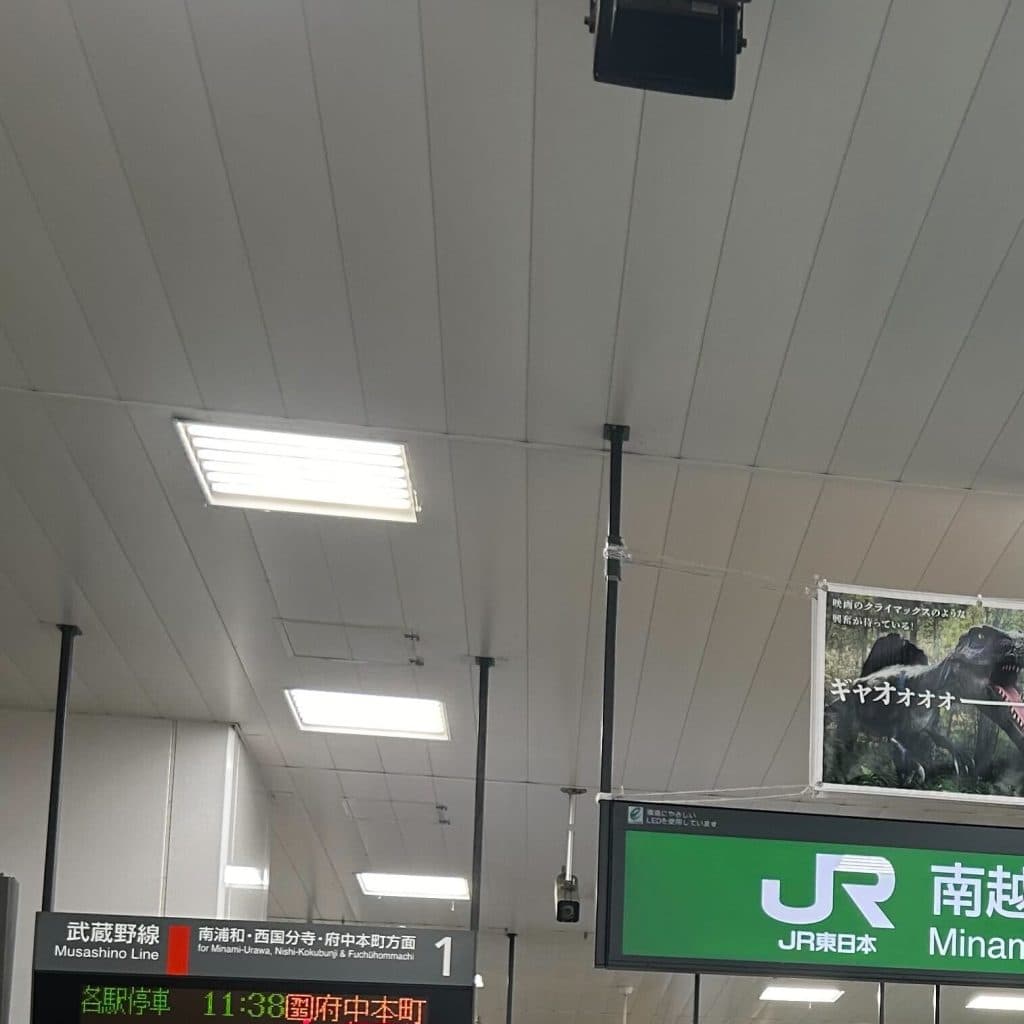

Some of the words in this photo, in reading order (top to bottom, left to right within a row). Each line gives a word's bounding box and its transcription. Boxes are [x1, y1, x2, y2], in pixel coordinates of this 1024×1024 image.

[761, 853, 896, 930] JR
[66, 921, 160, 945] 武蔵野線
[198, 926, 417, 950] 南浦和・西国分寺・府中本町方面
[778, 931, 877, 956] JR東日本
[54, 945, 127, 960] Musashino
[131, 947, 160, 961] Line
[198, 944, 210, 953] for
[339, 949, 346, 958] &
[434, 936, 452, 977] 1
[81, 985, 171, 1016] 各駅停車
[203, 991, 285, 1018] 11:38
[315, 994, 427, 1024] 府中本町
